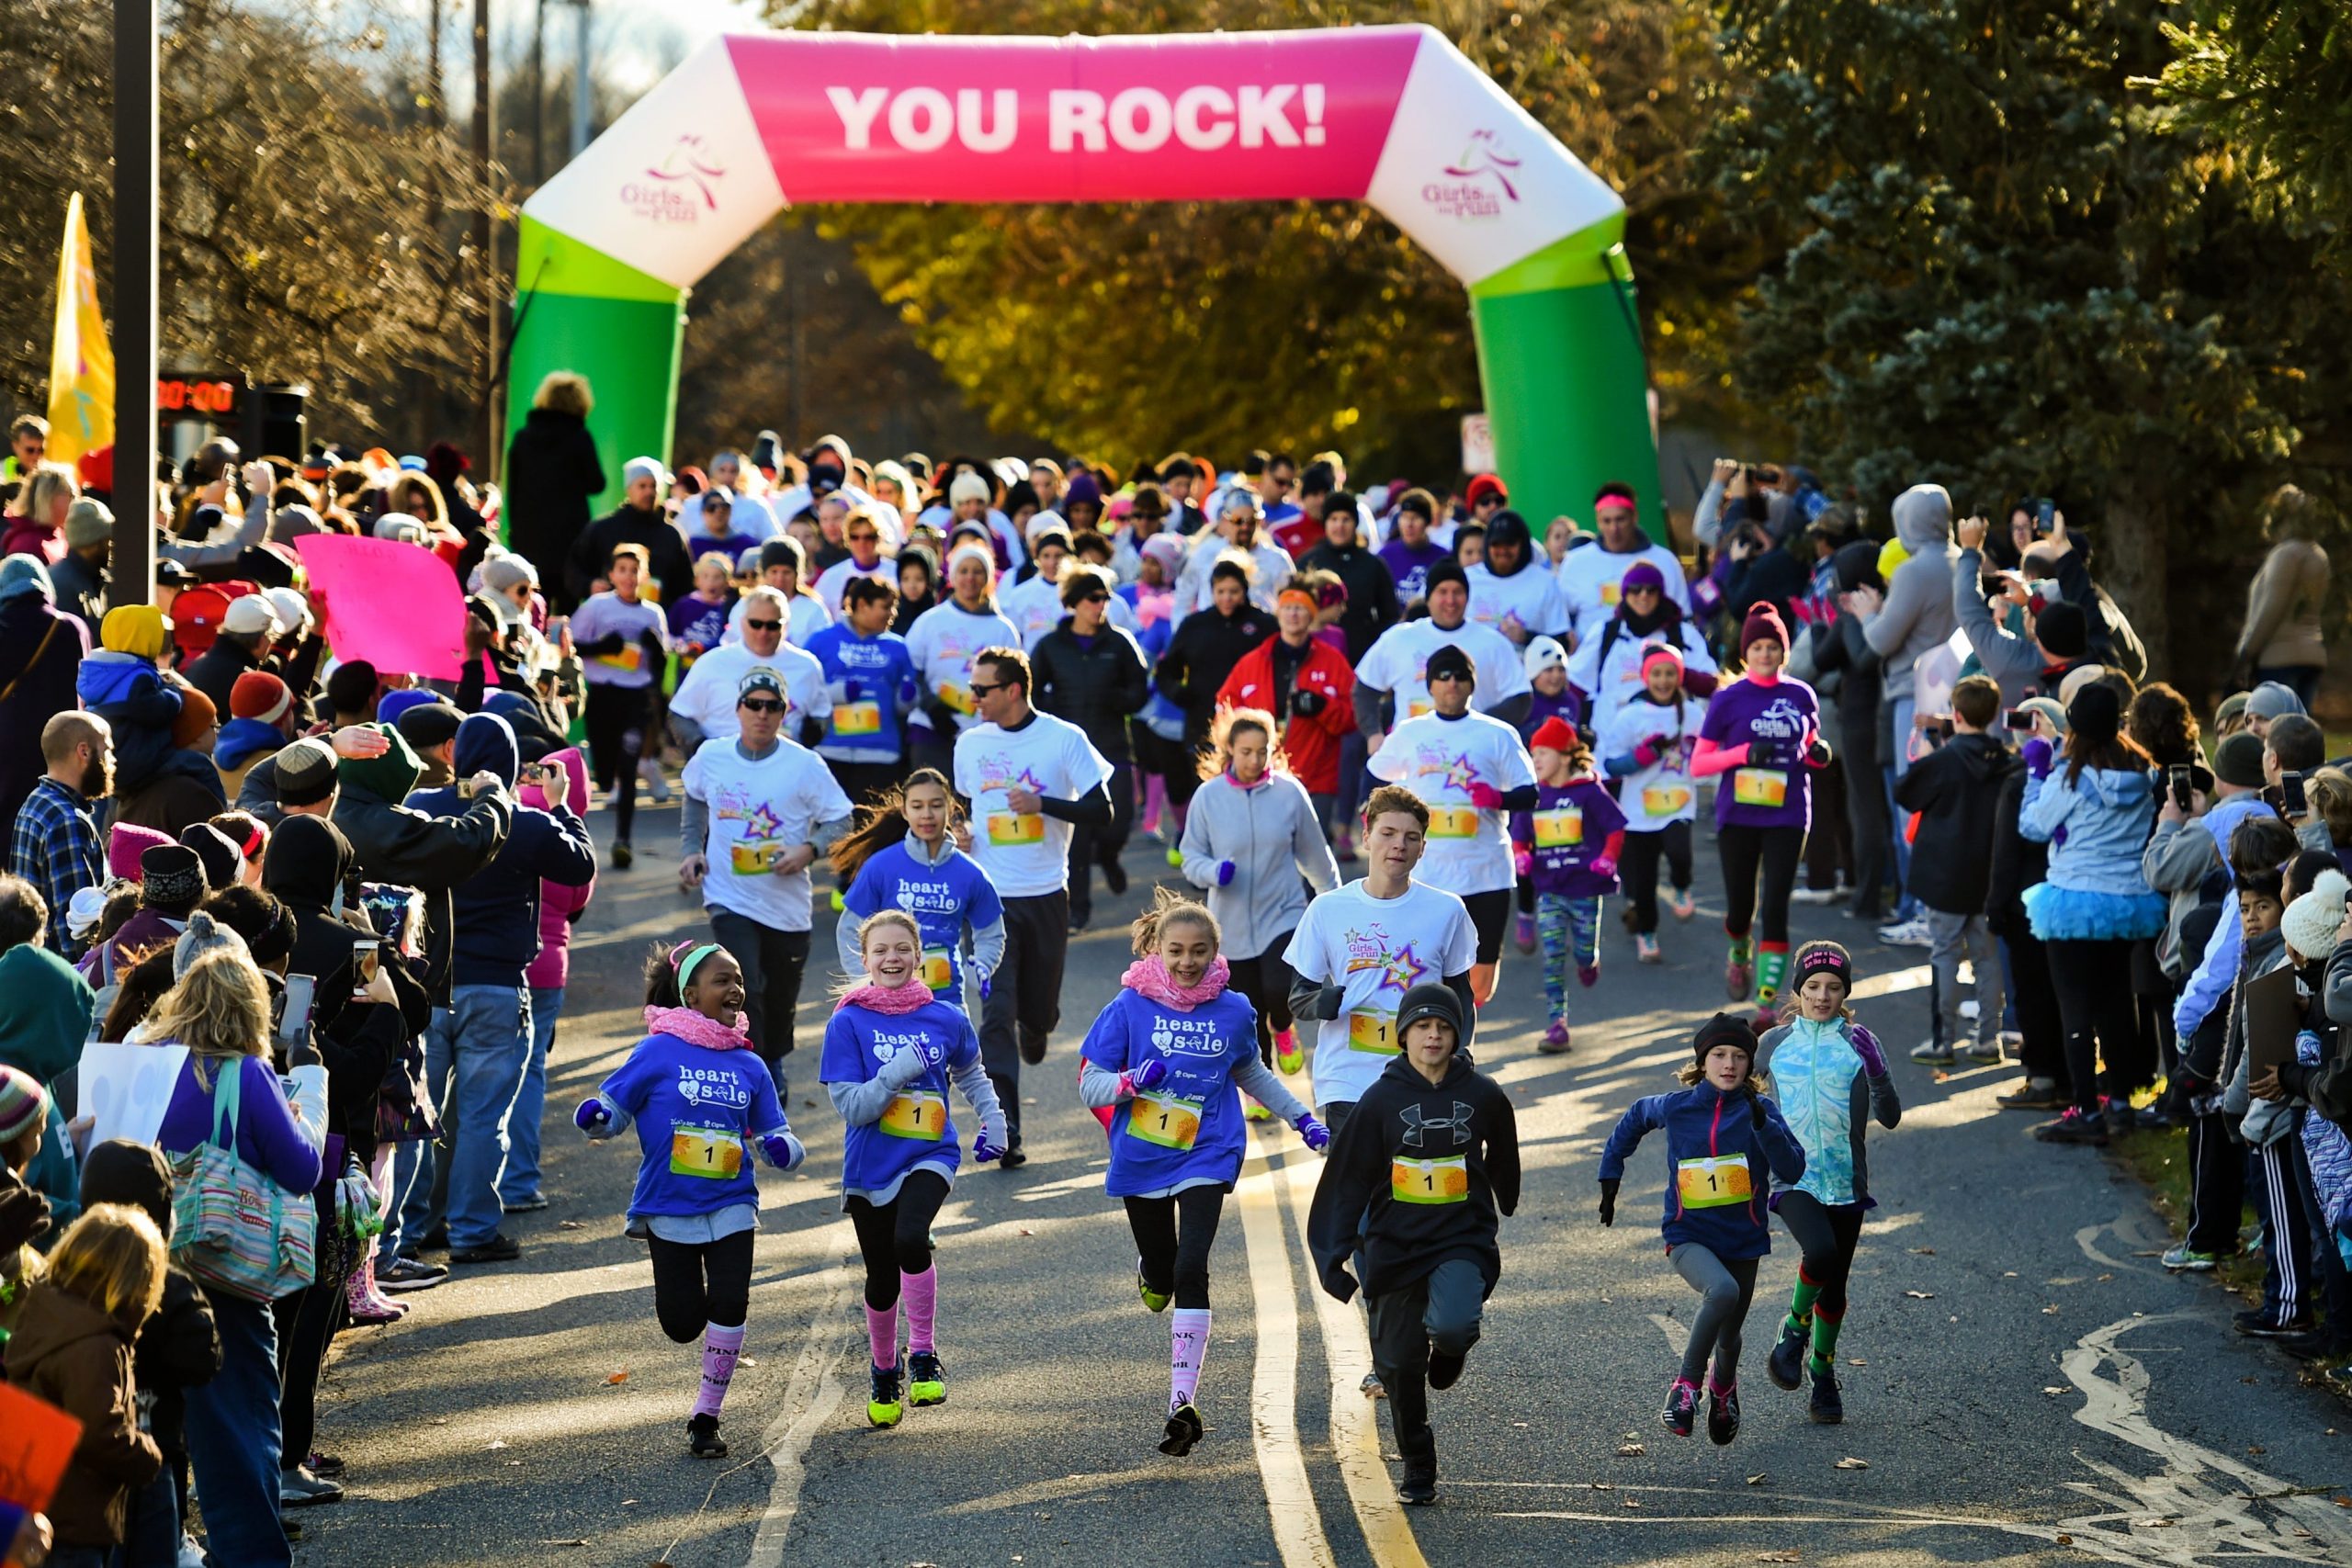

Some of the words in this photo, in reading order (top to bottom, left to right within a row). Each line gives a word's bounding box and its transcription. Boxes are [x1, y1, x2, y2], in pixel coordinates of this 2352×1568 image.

[825, 85, 1019, 153] YOU
[1048, 84, 1326, 152] ROCK!
[1012, 820, 1019, 834] 1
[1446, 815, 1453, 829] 1
[753, 852, 762, 865] 1
[898, 878, 950, 896] heart
[1349, 943, 1373, 953] Girls
[919, 964, 926, 978] 1
[1154, 1015, 1216, 1032] heart
[873, 1029, 930, 1045] heart
[1378, 1025, 1386, 1042] 1
[679, 1066, 739, 1086] heart
[912, 1106, 922, 1124] 1
[1159, 1113, 1169, 1130] 1
[705, 1145, 714, 1164] 1
[1423, 1174, 1433, 1191] 1
[1707, 1174, 1717, 1192] 1
